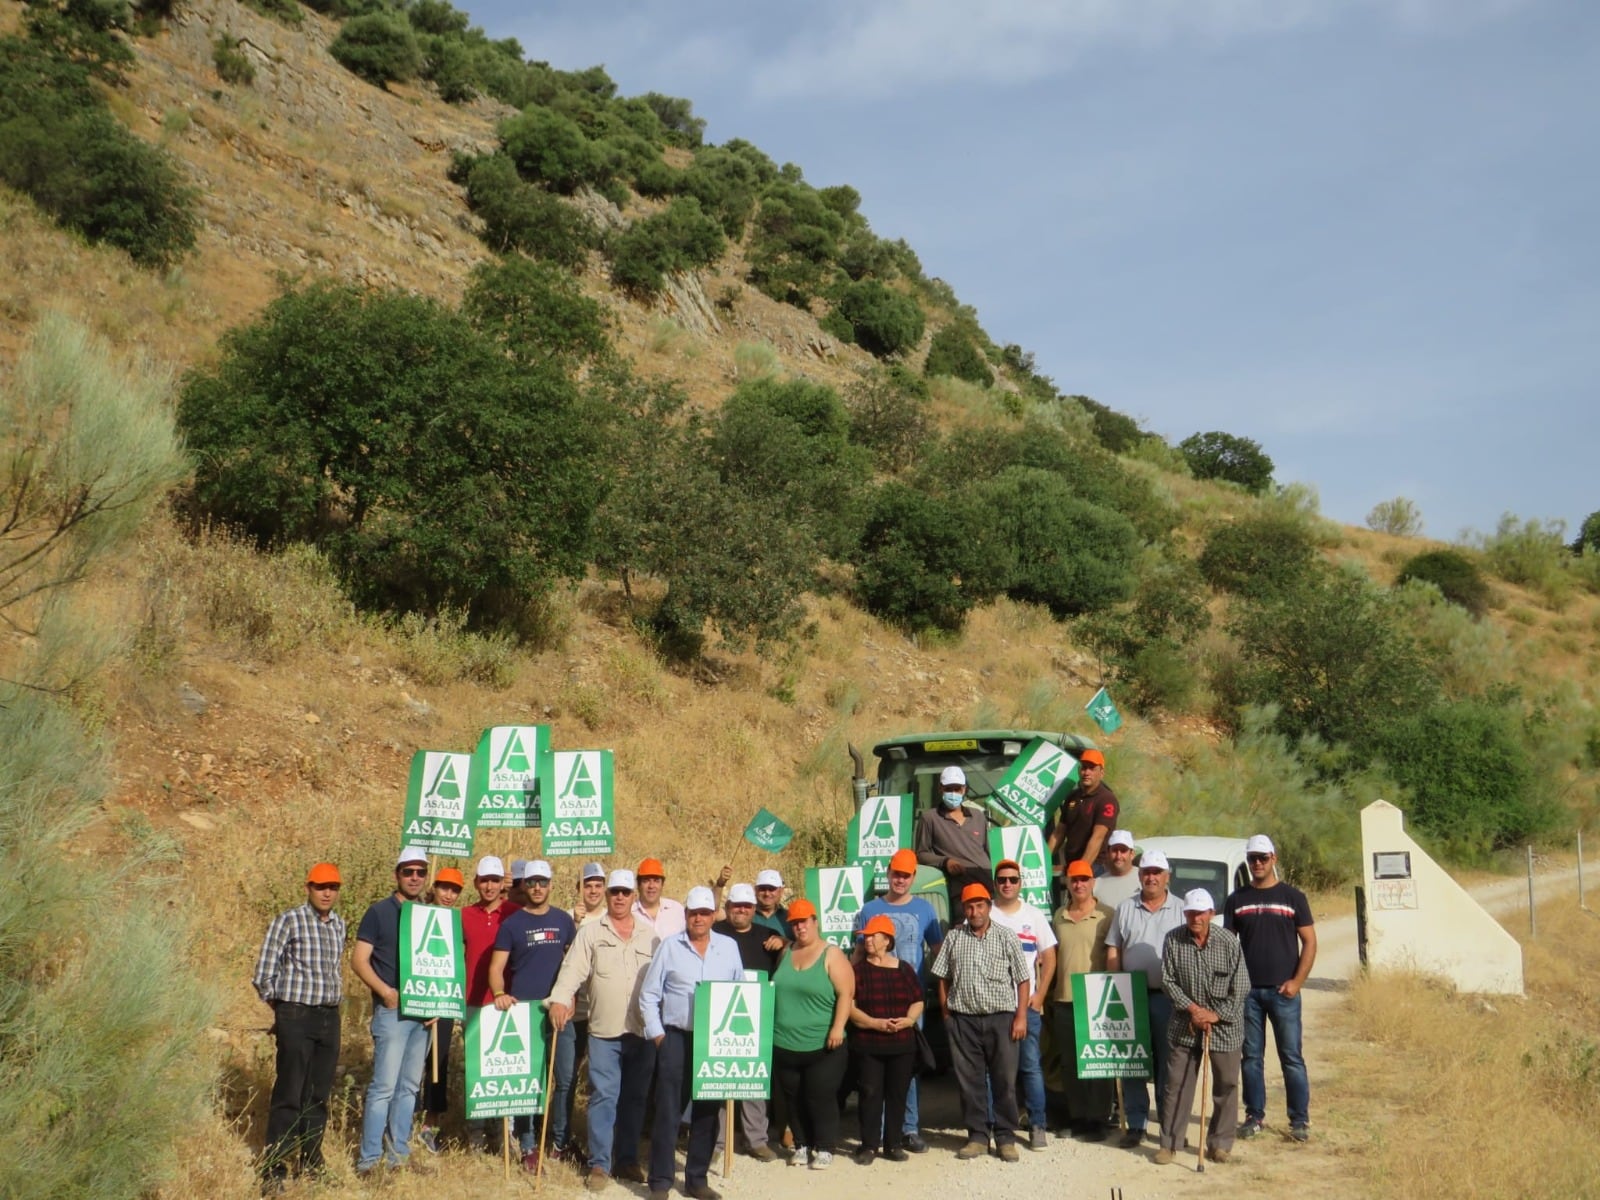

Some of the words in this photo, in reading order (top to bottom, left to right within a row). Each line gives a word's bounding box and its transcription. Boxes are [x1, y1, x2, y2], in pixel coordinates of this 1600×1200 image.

[494, 774, 531, 782] ASAJA
[1022, 775, 1048, 798] ASAJA
[424, 800, 460, 810] ASAJA
[478, 794, 541, 808] ASAJA
[560, 800, 597, 808] ASAJA
[997, 784, 1045, 824] ASAJA
[1103, 803, 1115, 817] 3
[406, 820, 472, 839] ASAJA
[546, 821, 611, 837] ASAJA
[863, 840, 895, 848] ASAJA
[826, 914, 860, 923] ASAJA
[416, 958, 452, 968] ASAJA
[403, 979, 463, 999] ASAJA
[1094, 1022, 1130, 1031] ASAJA
[714, 1037, 755, 1046] ASAJA
[1080, 1044, 1148, 1059] ASAJA
[485, 1056, 526, 1066] ASAJA
[697, 1061, 768, 1078] ASAJA
[470, 1078, 543, 1098] ASAJA
